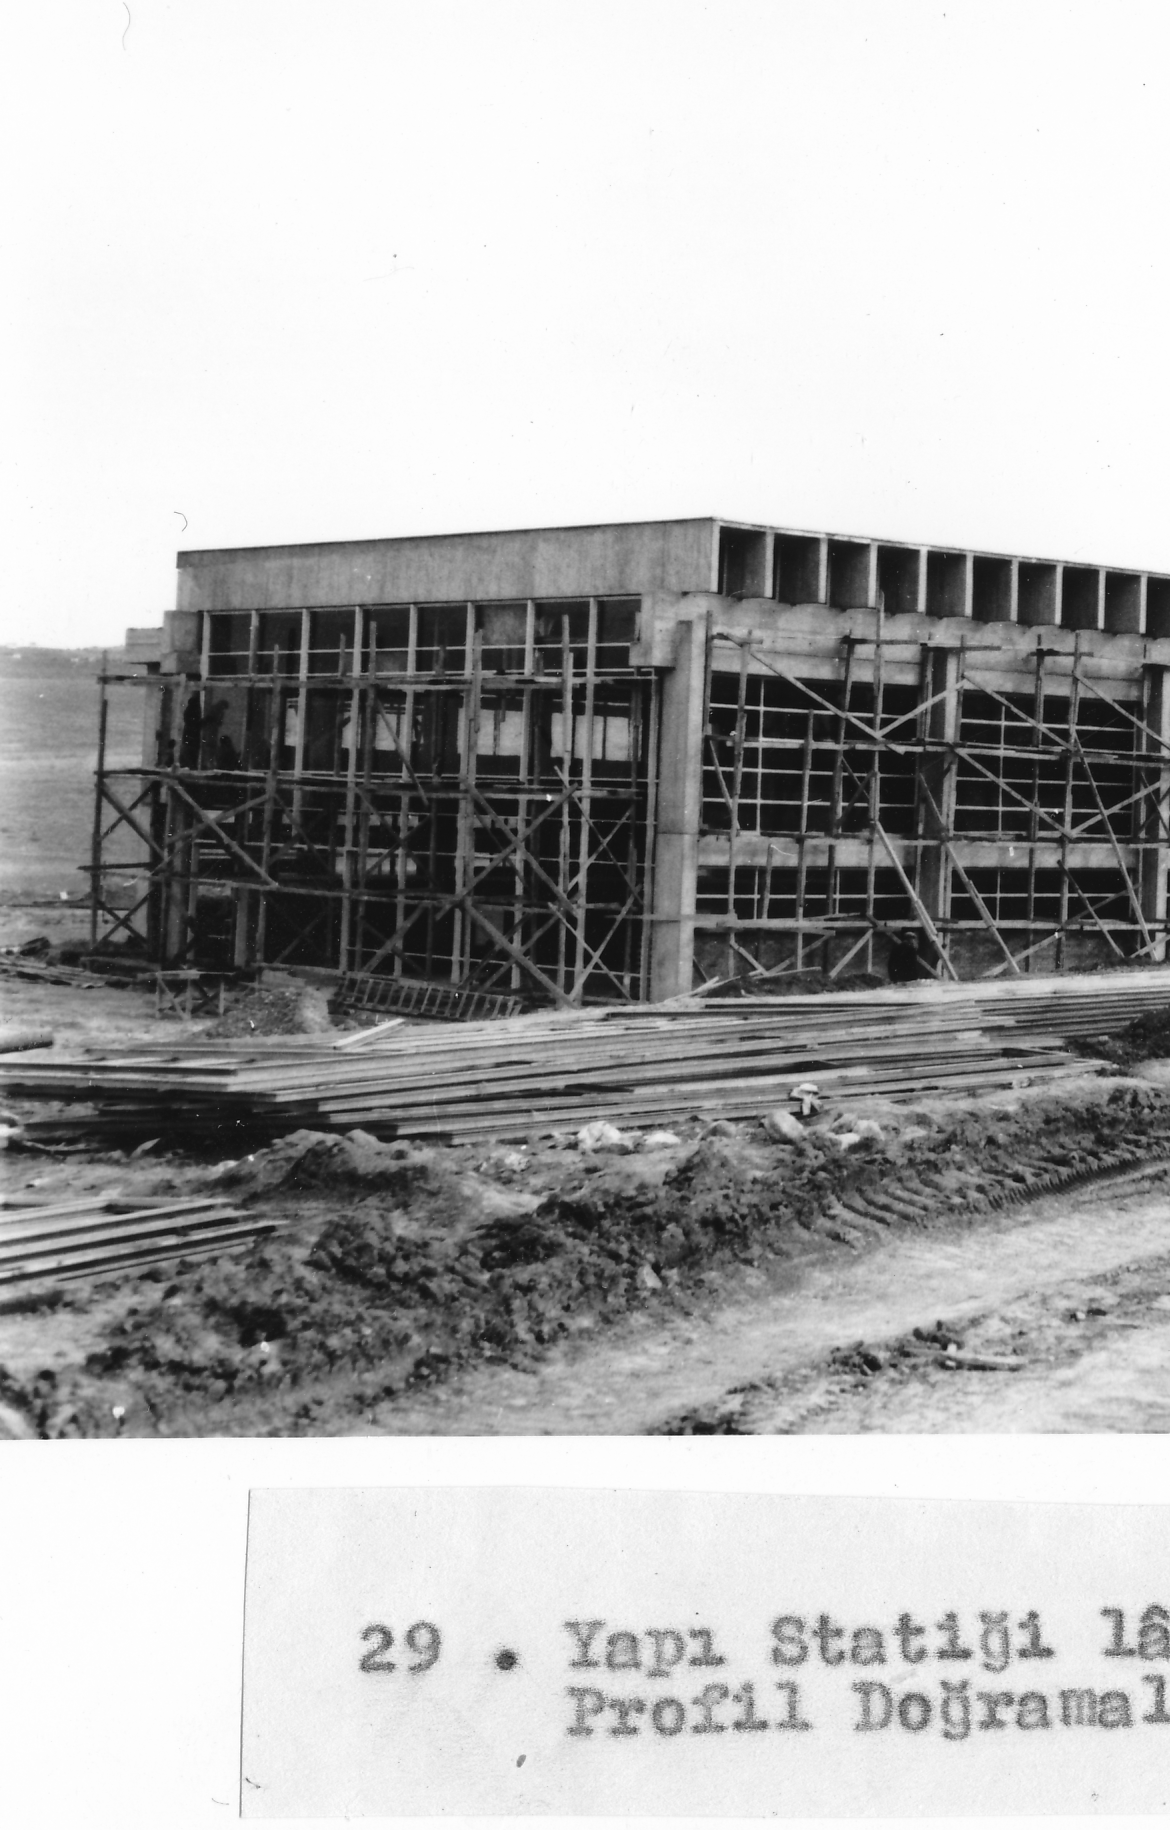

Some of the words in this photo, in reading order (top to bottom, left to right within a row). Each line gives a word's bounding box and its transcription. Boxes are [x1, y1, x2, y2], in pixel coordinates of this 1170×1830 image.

[358, 1621, 443, 1674] 29
[564, 1619, 727, 1678] Yapı
[770, 1610, 1056, 1674] Statiği
[565, 1680, 813, 1738] Profil
